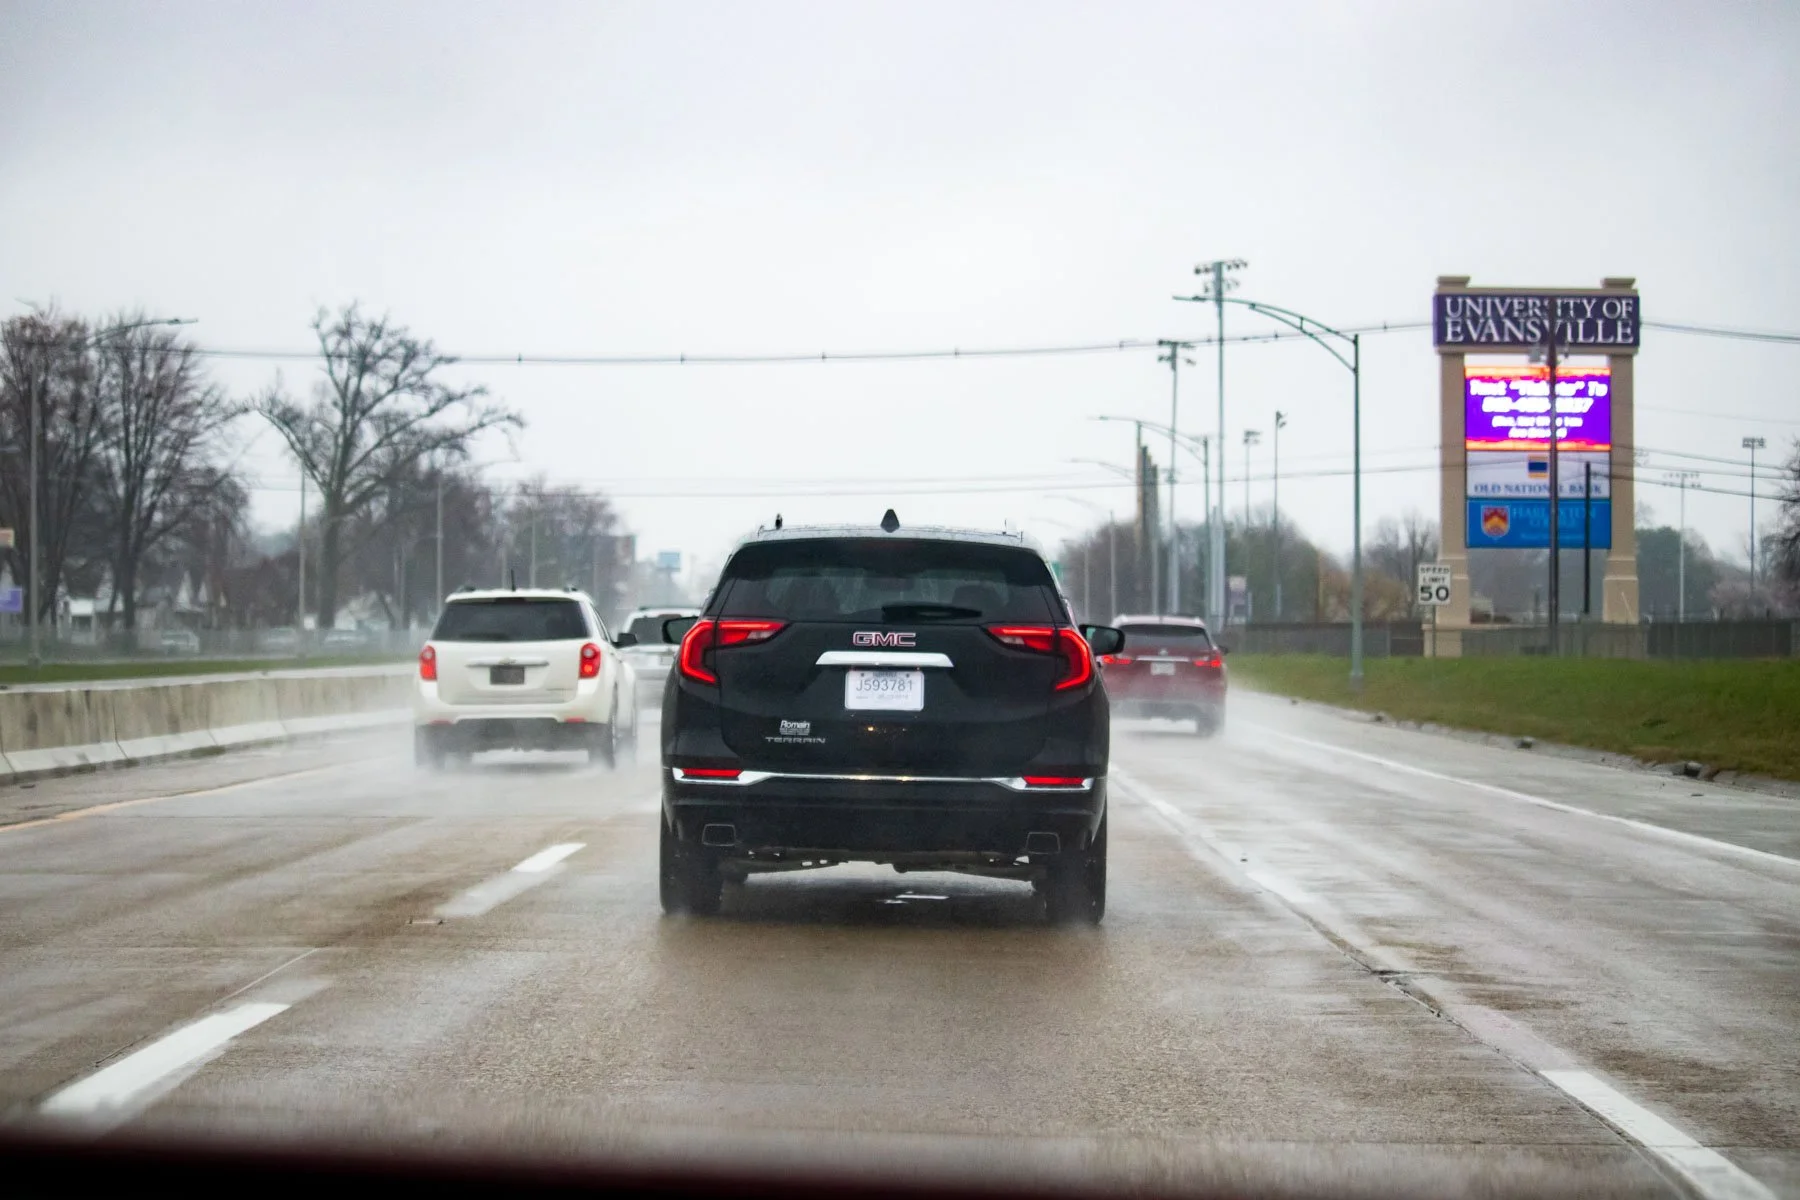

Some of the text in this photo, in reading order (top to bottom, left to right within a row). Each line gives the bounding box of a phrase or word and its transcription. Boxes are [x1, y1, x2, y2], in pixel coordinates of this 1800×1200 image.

[1602, 299, 1633, 319] OF
[1445, 317, 1634, 344] EVANSVILLE
[1474, 483, 1601, 495] OLD NATIONL BAK
[1420, 566, 1450, 574] SPEED
[1420, 585, 1449, 601] 50
[852, 631, 917, 647] GMC
[856, 679, 913, 691] J593781
[764, 736, 826, 744] TERRAIN
